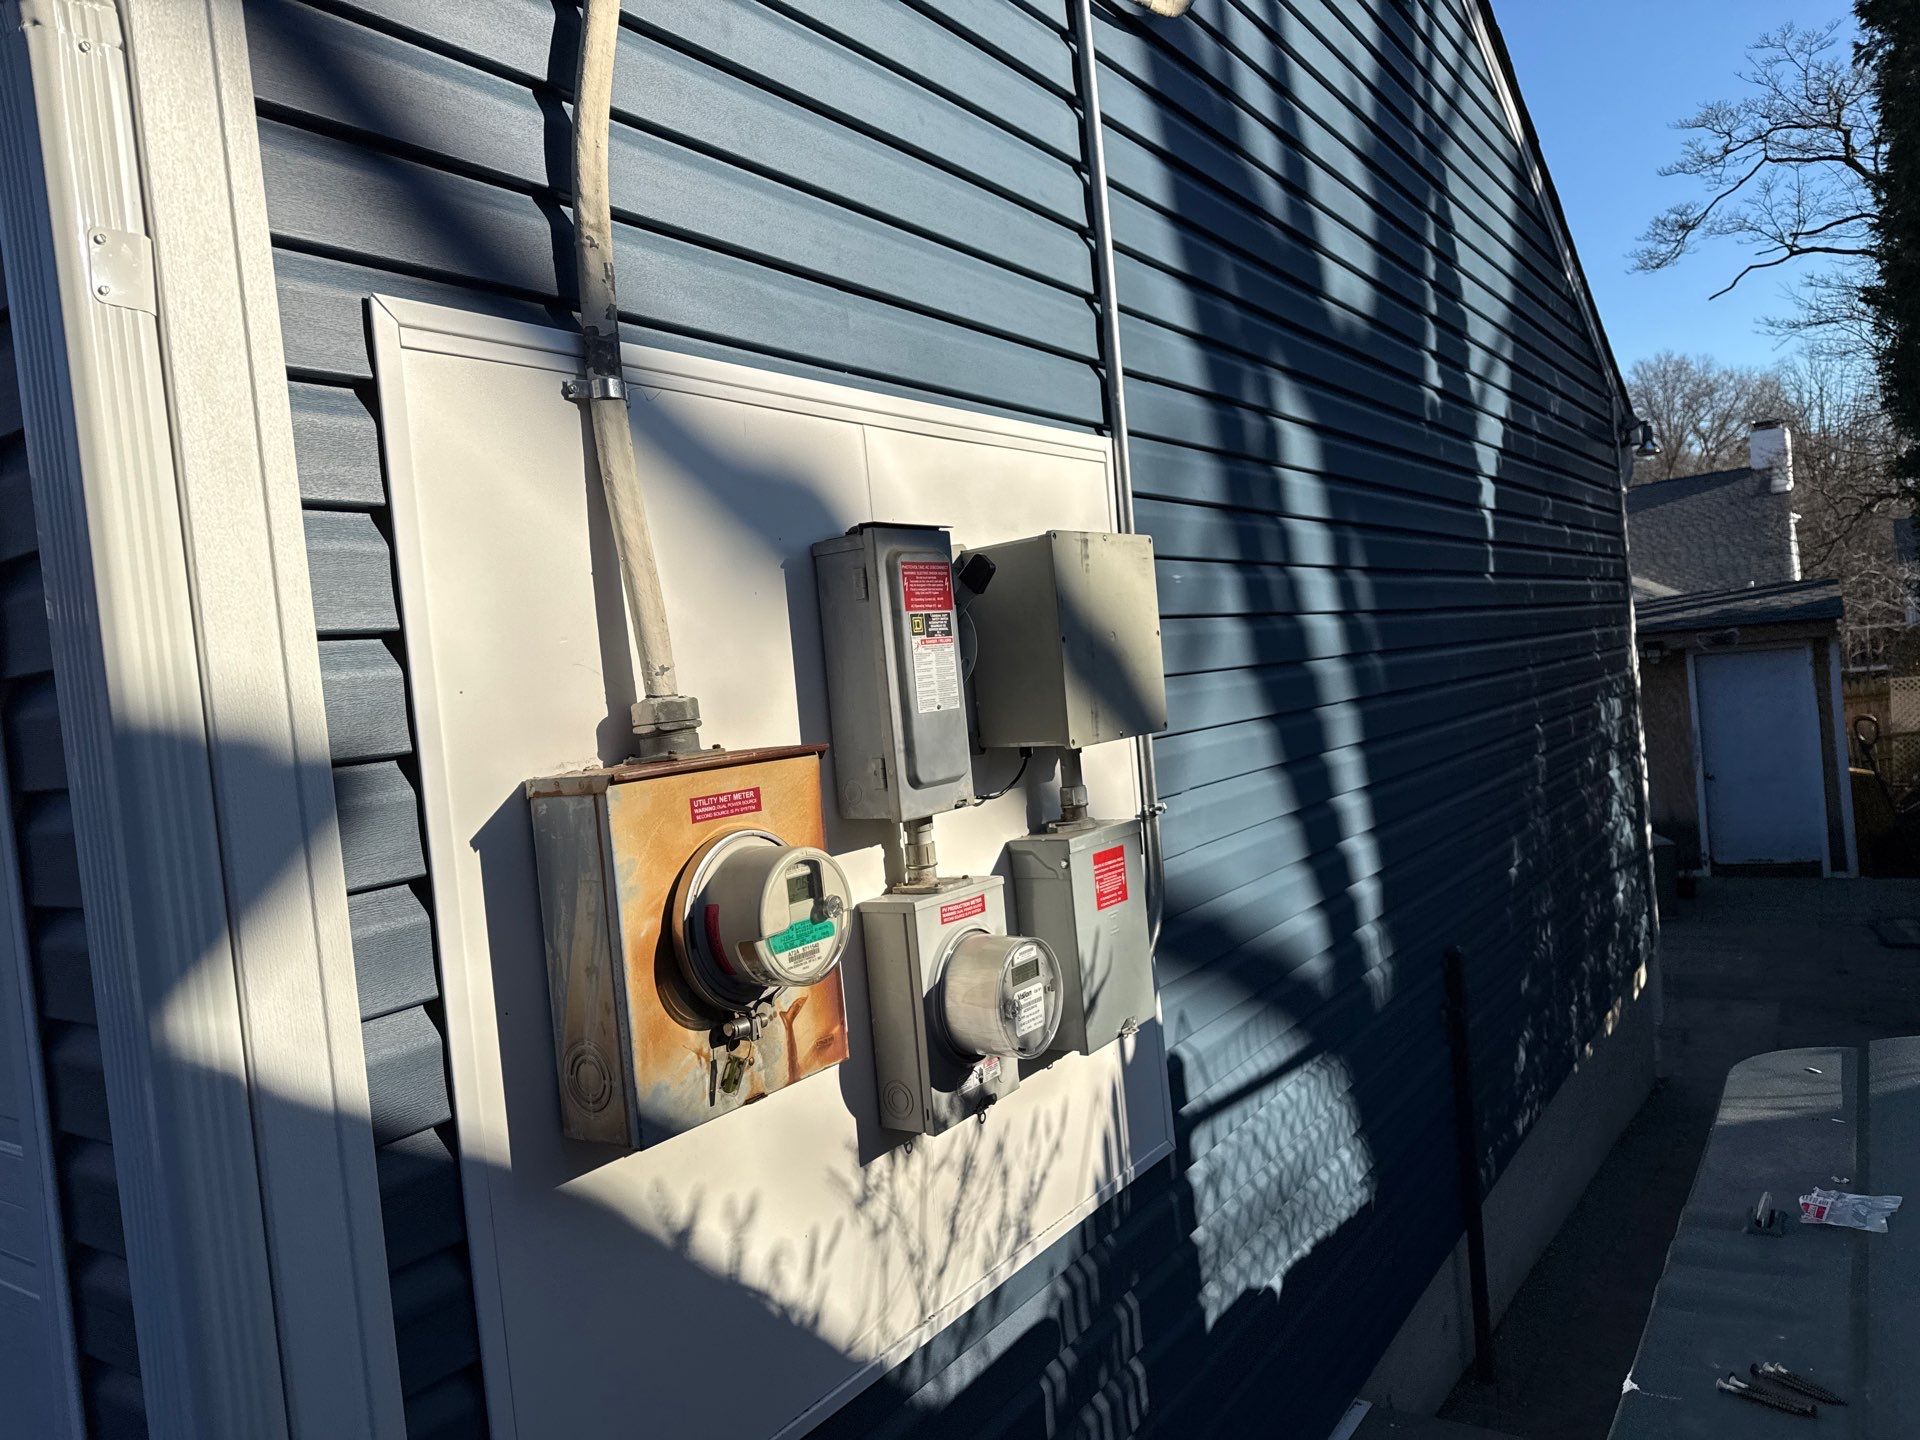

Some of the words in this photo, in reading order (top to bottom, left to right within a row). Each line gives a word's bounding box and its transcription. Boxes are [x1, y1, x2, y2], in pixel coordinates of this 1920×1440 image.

[694, 797, 717, 807] UTILITY
[719, 794, 731, 803] NET
[733, 790, 754, 800] METER
